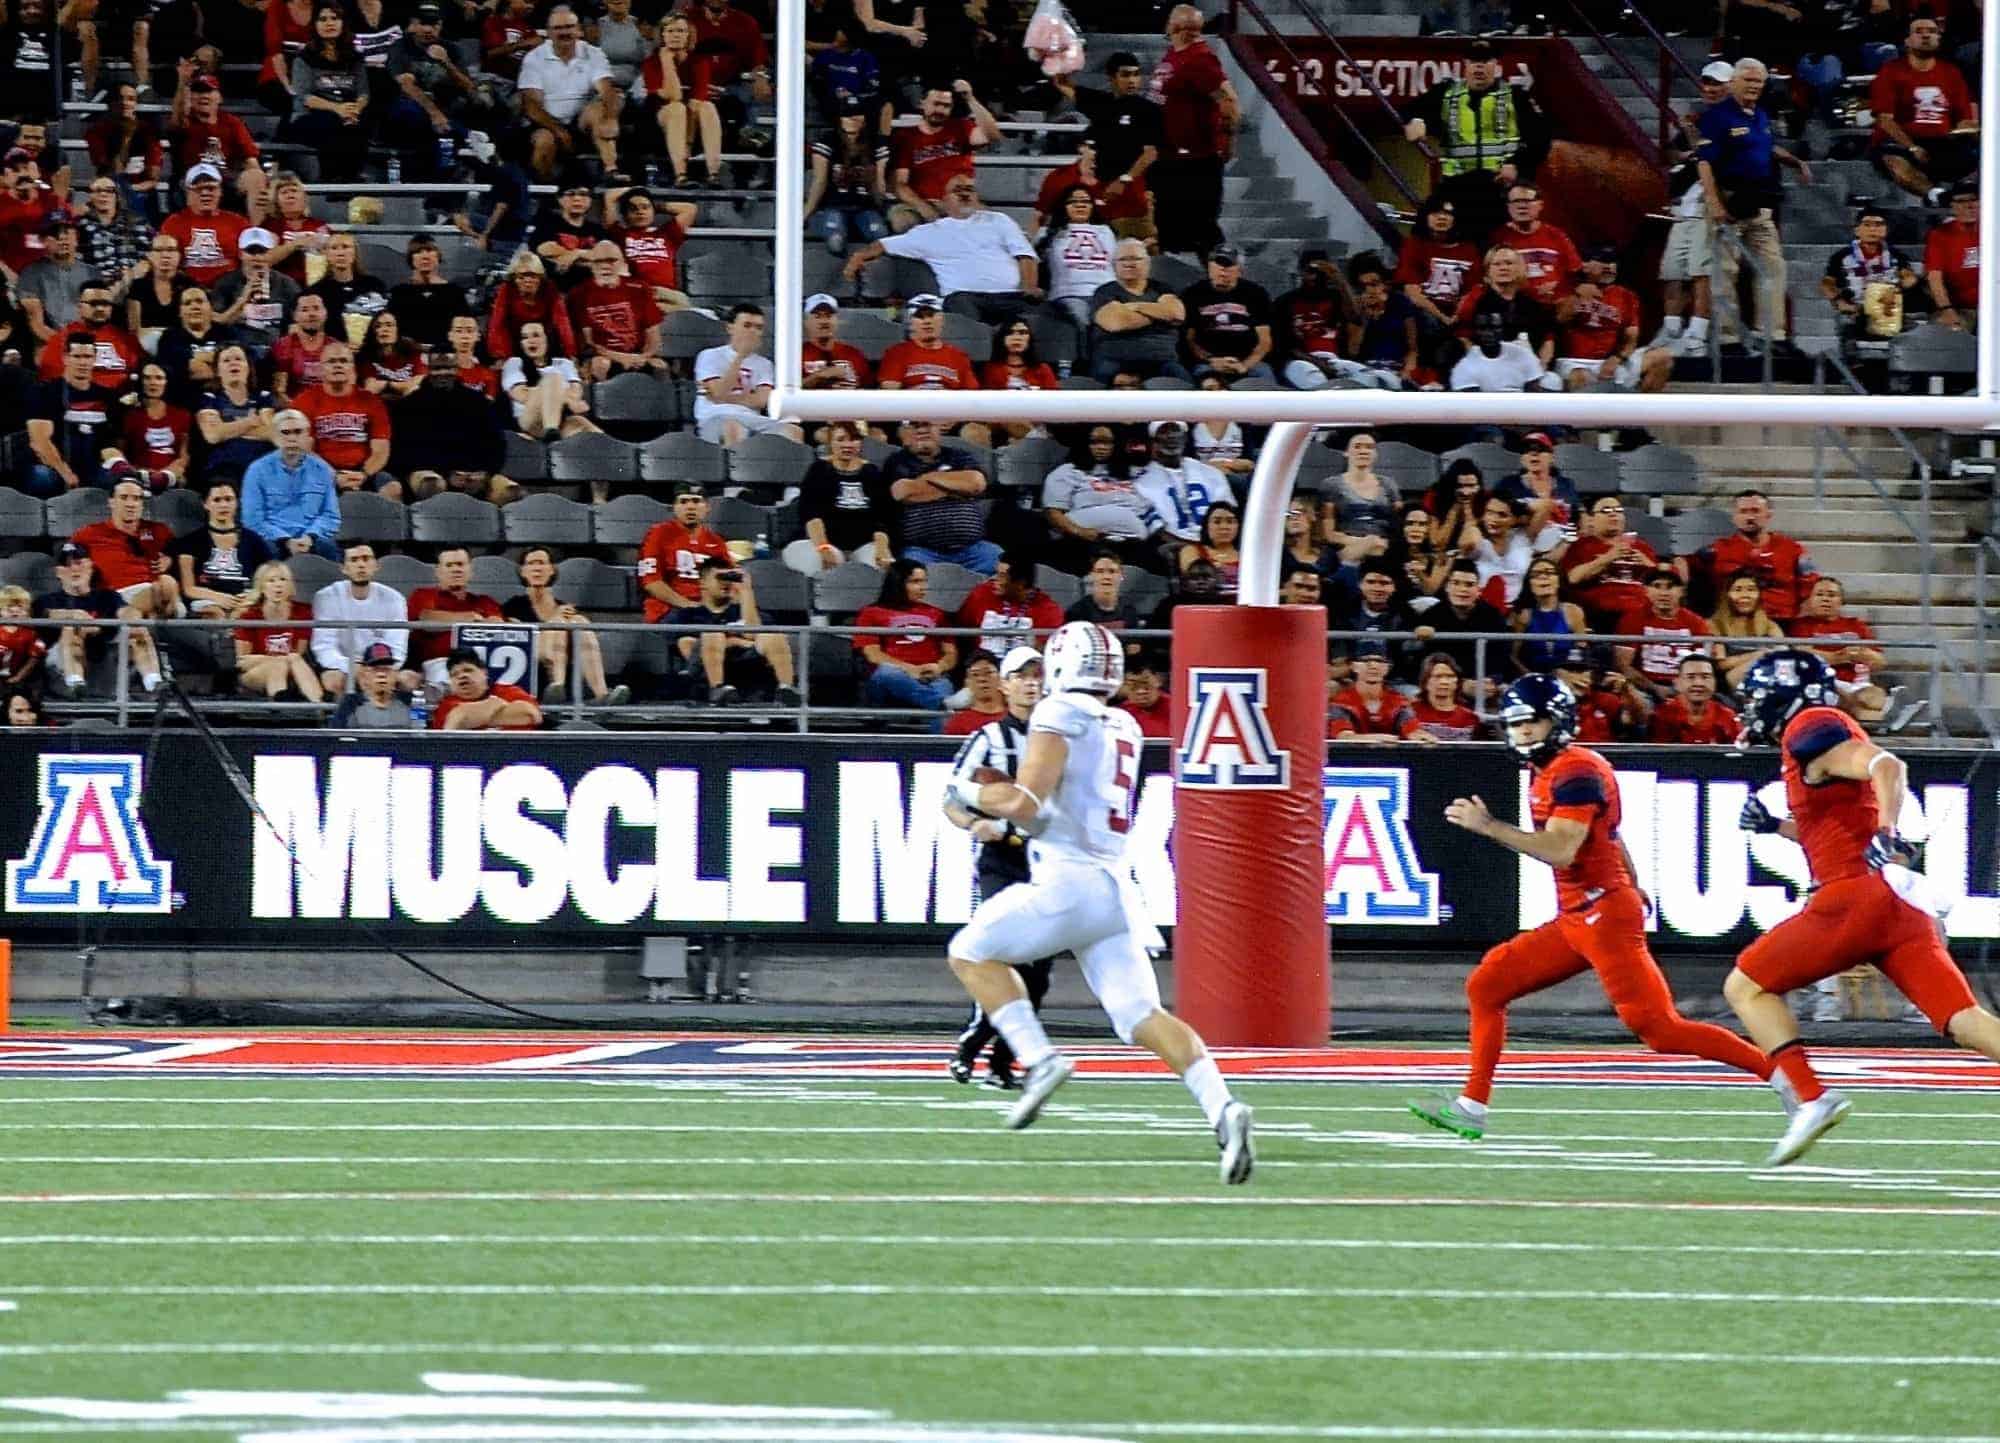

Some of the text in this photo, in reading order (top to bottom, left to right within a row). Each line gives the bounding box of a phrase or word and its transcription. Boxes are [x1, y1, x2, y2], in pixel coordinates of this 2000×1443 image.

[462, 628, 529, 642] SECTION
[1108, 739, 1134, 835] 5
[1176, 667, 1291, 791] A
[5, 753, 173, 914] A
[252, 754, 806, 924] MUSCLE
[1325, 767, 1441, 926] A
